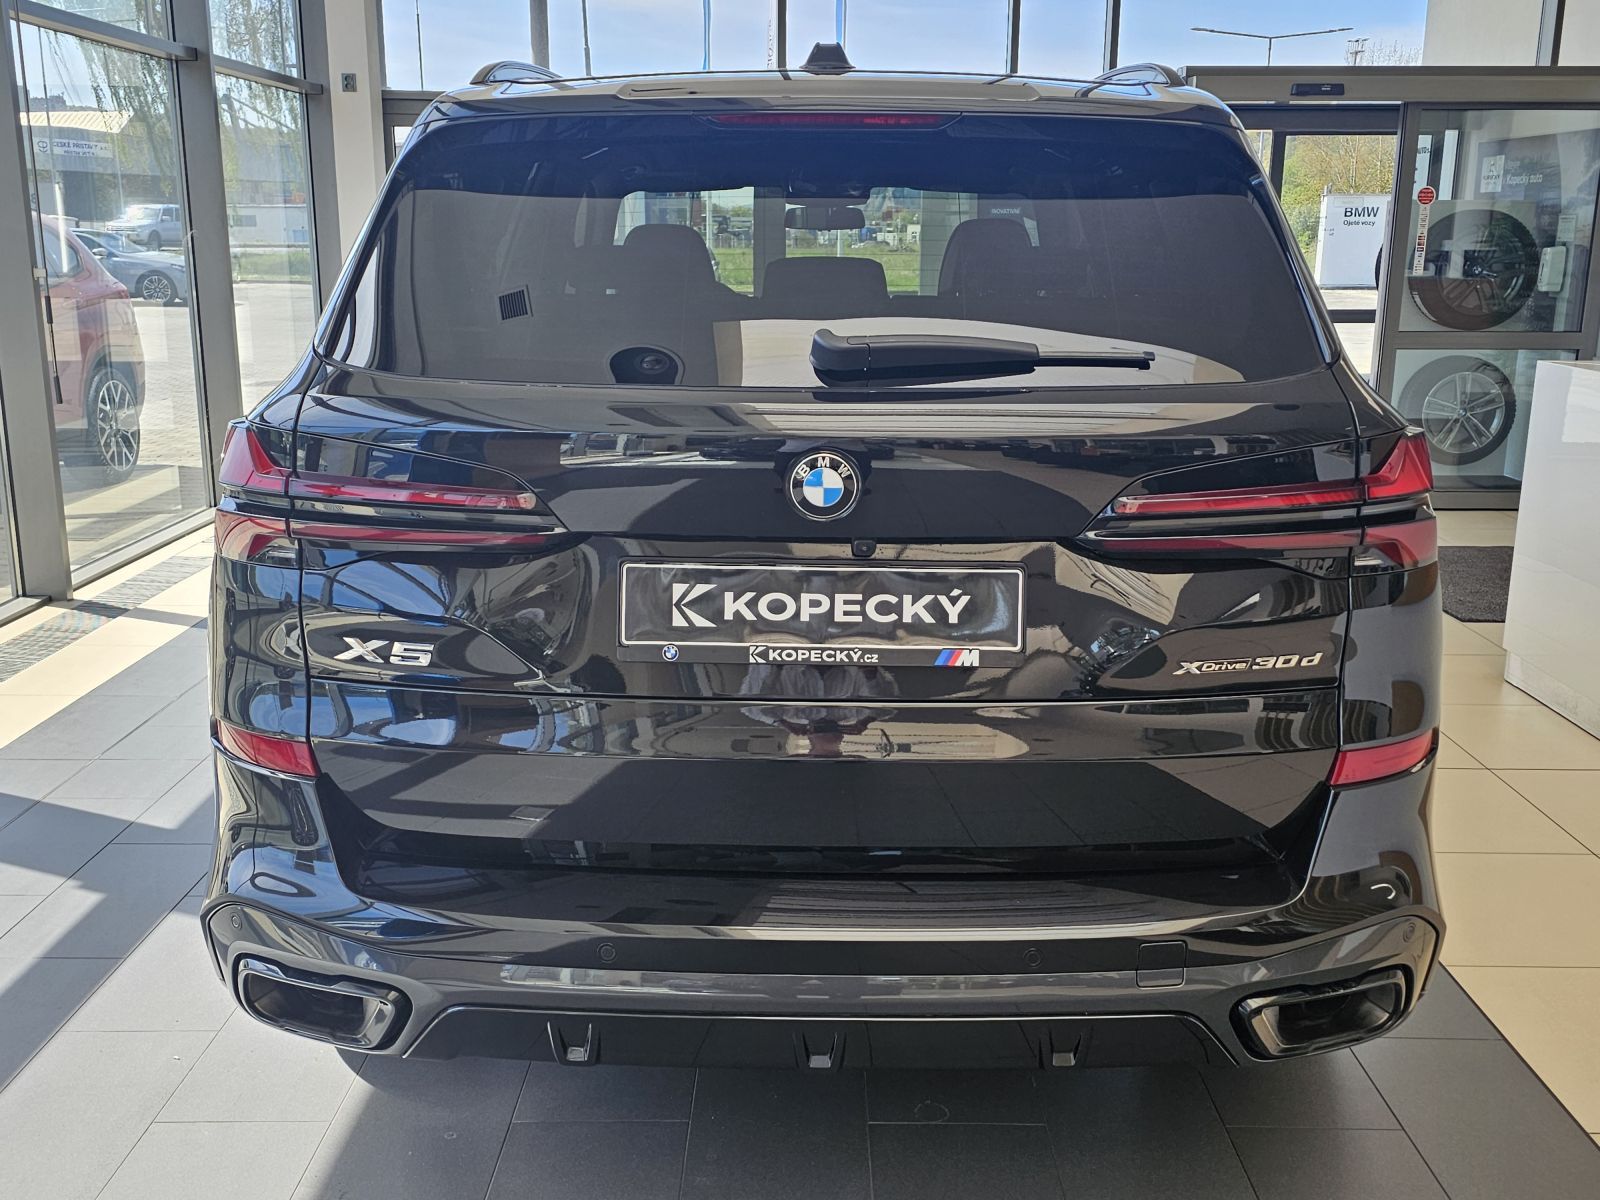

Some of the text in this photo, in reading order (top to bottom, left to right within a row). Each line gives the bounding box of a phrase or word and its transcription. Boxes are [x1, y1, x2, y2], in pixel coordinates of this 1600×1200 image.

[1343, 219, 1360, 227] Ojeté
[1344, 206, 1380, 218] BMW
[797, 456, 851, 478] BMW
[723, 588, 972, 624] KOPECKÝ
[333, 636, 435, 667] X5
